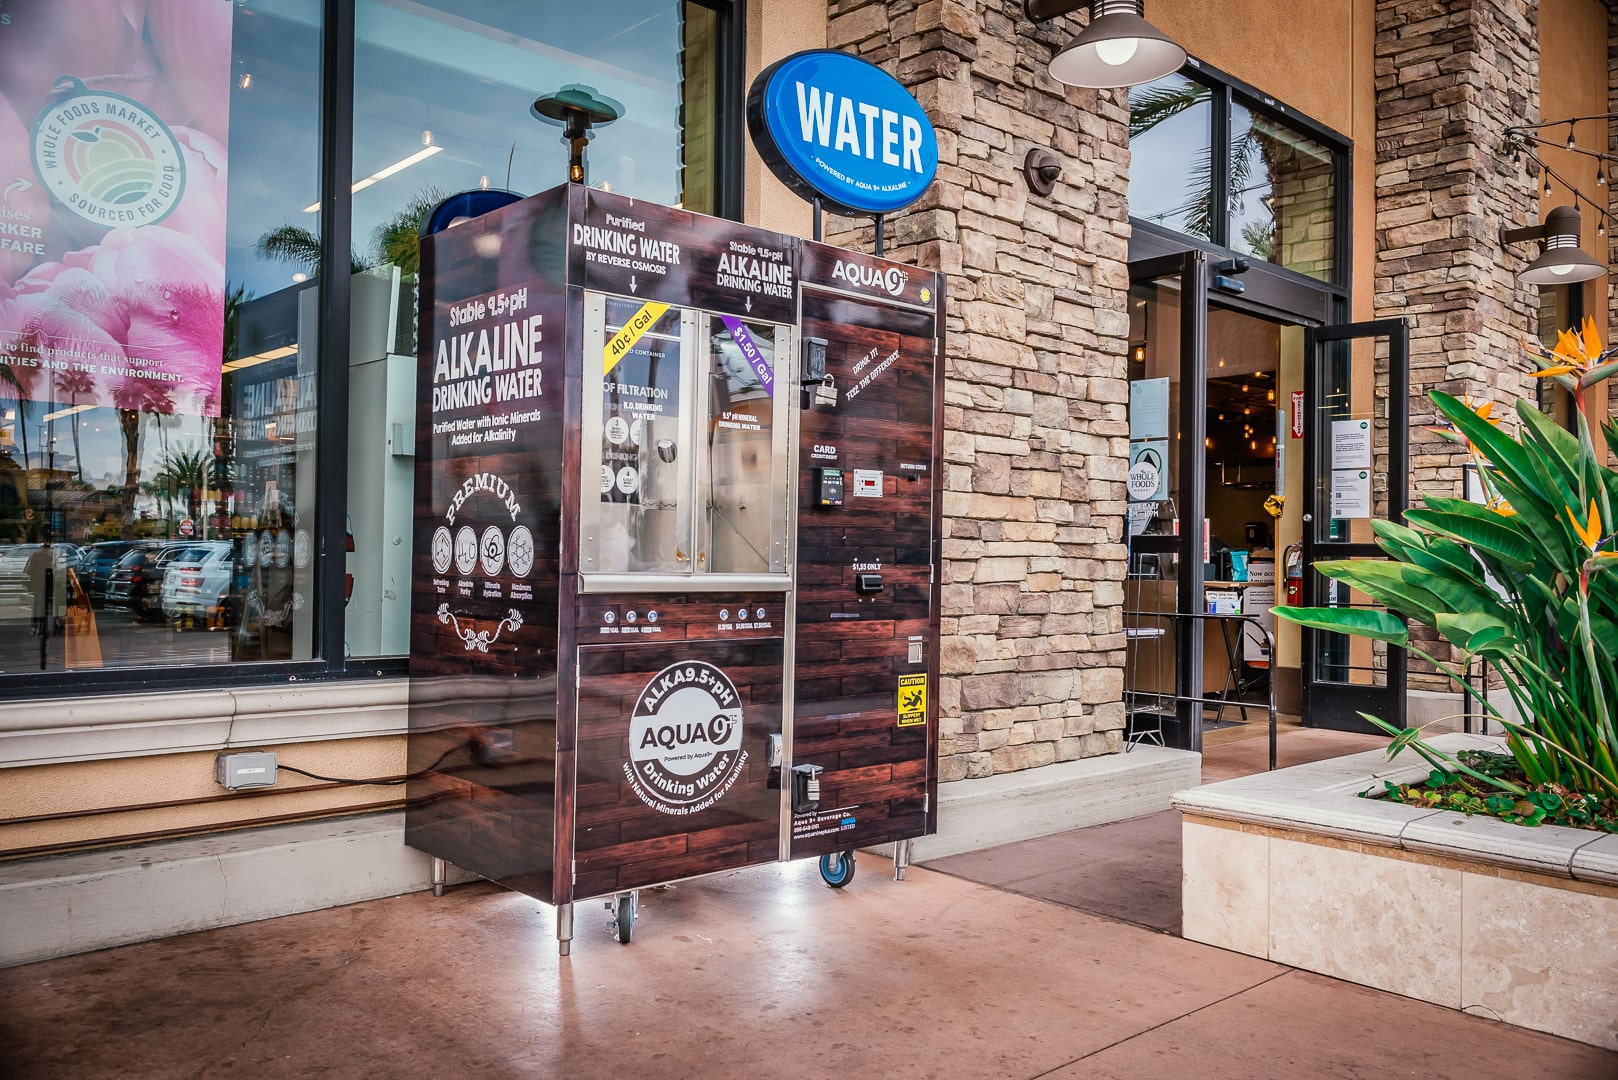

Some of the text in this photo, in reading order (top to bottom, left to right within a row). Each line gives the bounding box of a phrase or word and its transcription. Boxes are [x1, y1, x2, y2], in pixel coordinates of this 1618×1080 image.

[45, 102, 161, 170] WHOLE FOODS MARKET
[796, 81, 924, 174] WATER
[815, 157, 845, 181] POWERED
[846, 176, 854, 185] BY
[855, 181, 872, 190] AQUA
[881, 181, 907, 192] ALKALINE
[69, 164, 175, 222] SOURCED FOR GOOD
[0, 206, 30, 221] ises
[605, 213, 645, 232] Purified
[573, 224, 681, 265] DRINKING WATER
[729, 241, 756, 254] Stable
[586, 251, 667, 275] BY REVERSE OSMOSIS
[717, 253, 793, 286] ALKALINE
[716, 273, 793, 299] DRINKING WATER
[449, 301, 485, 328] Stable
[611, 332, 632, 356] 40¢
[634, 310, 652, 329] Gal
[5, 343, 164, 367] to find products that support
[433, 314, 543, 384] ALKALINE
[635, 349, 666, 358] CONTAINER
[734, 327, 756, 358] $1.50
[757, 364, 773, 385] Gal
[42, 359, 69, 370] AND
[73, 363, 97, 373] THE
[101, 366, 185, 383] ENVIRONMENT.
[432, 368, 543, 413] DRINKING WATER
[617, 383, 668, 399] FILTRATION
[623, 402, 634, 410] R.O.
[635, 403, 663, 412] DRINKING
[632, 412, 656, 420] WATER
[433, 409, 541, 434] Purified Water with Ionic Minerals
[718, 421, 761, 431] DRINKING WATER
[451, 428, 517, 446] Added for Alkalinity
[813, 445, 836, 454] CARD
[1130, 473, 1156, 481] WHOLE
[1131, 480, 1155, 488] FOODS
[446, 472, 521, 526] PREMIUM
[867, 563, 882, 571] ONLY
[900, 677, 925, 686] CAUTION
[663, 753, 687, 762] Powered
[687, 753, 694, 761] by
[631, 781, 656, 809] Natural
[655, 803, 689, 816] Minerals
[689, 798, 715, 814] Added
[714, 787, 725, 801] for
[725, 750, 749, 791] Alkalinity
[643, 753, 730, 797] Drinking Water
